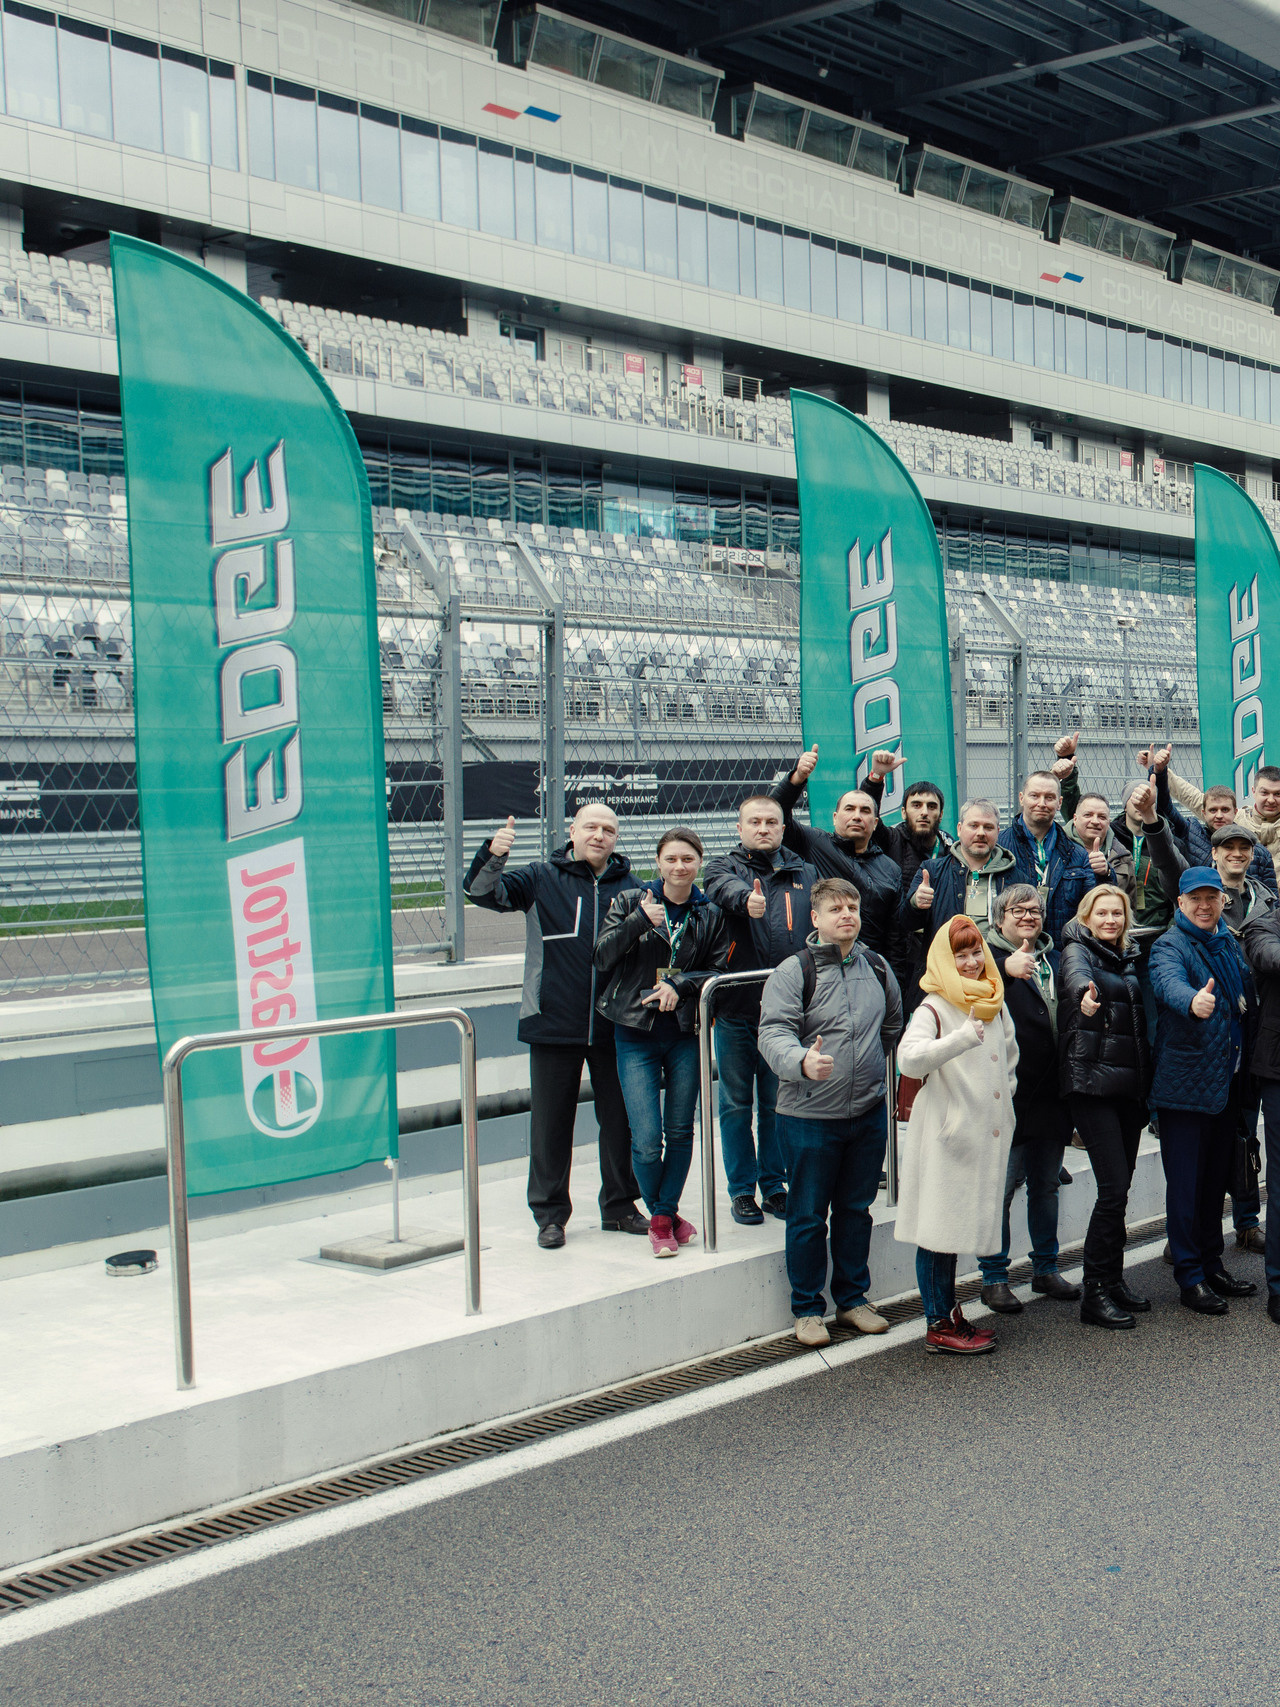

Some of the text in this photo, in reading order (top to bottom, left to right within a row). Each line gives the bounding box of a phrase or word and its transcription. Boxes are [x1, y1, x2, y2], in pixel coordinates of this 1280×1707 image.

[1101, 277, 1276, 349] СОЧИ АВТОДРОМ
[608, 796, 658, 805] PERFORMANCE
